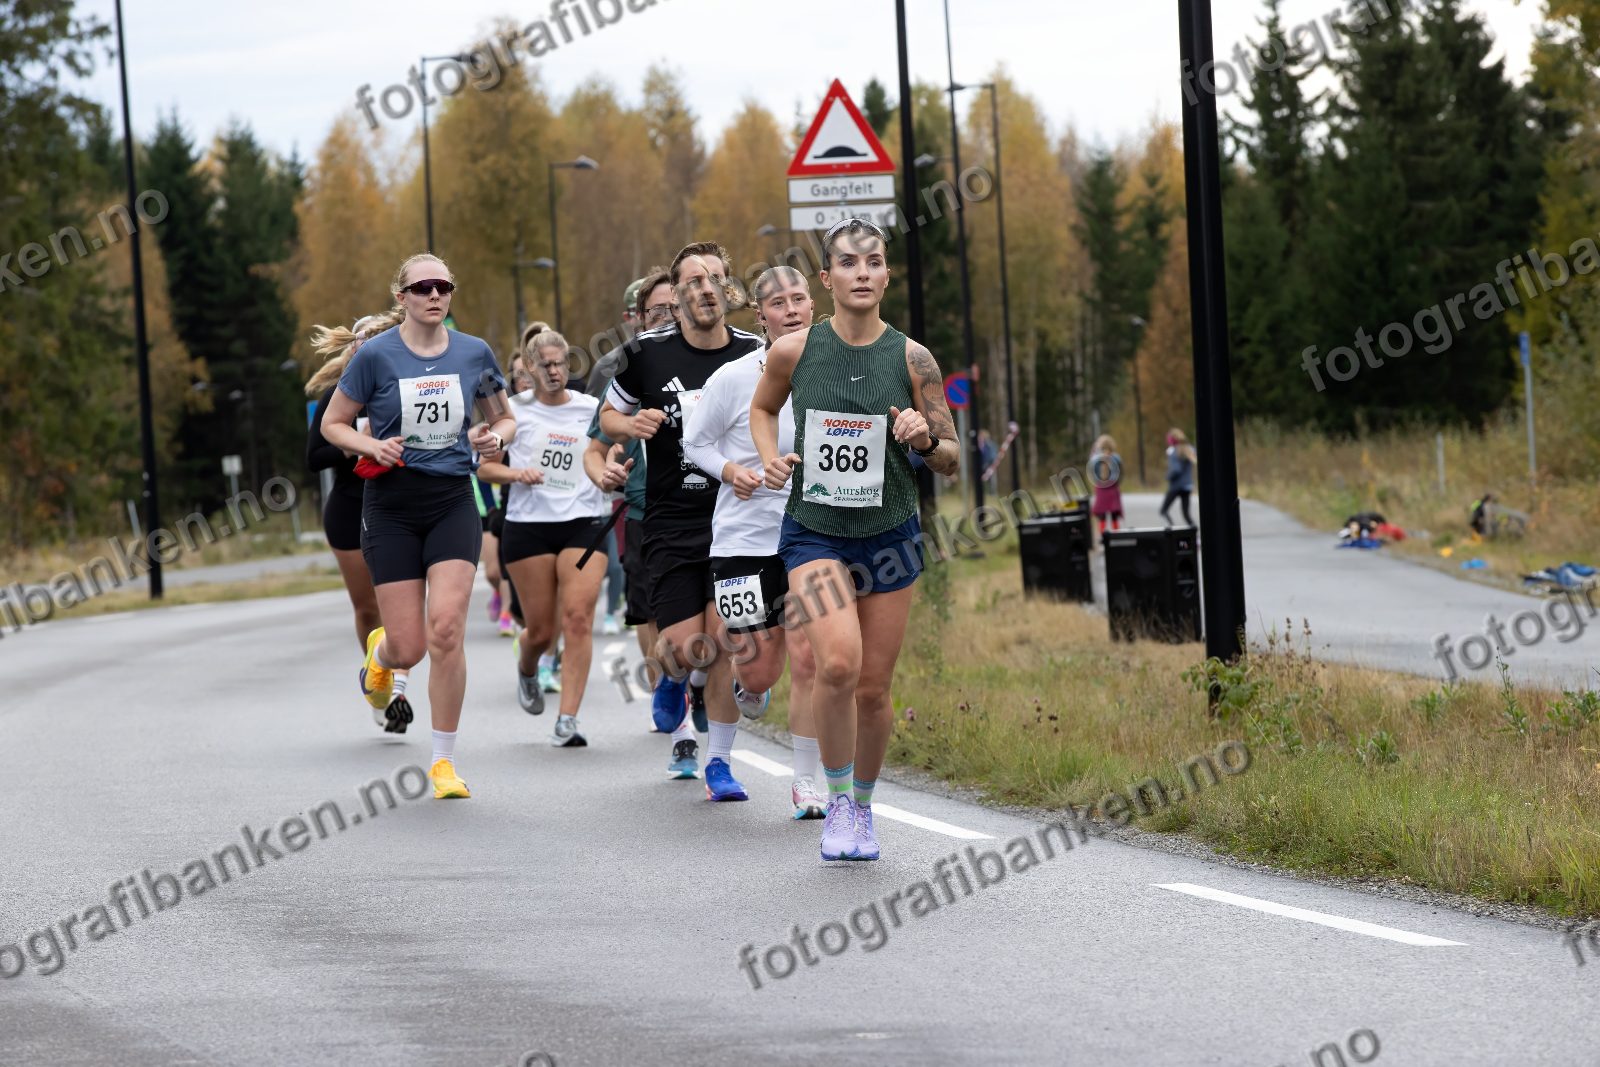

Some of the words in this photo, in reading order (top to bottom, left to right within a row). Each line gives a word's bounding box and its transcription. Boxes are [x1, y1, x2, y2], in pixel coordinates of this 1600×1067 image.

[810, 183, 874, 198] Gangfelt
[815, 212, 825, 225] 0
[415, 381, 450, 390] NORGES
[419, 387, 446, 397] LØPET
[414, 400, 449, 424] 731
[823, 418, 872, 430] NORGES
[826, 427, 864, 438] LØPET
[540, 449, 573, 471] 509
[818, 443, 869, 473] 368
[833, 485, 880, 498] Aurskog
[720, 576, 748, 588] LØPET
[719, 590, 758, 619] 653
